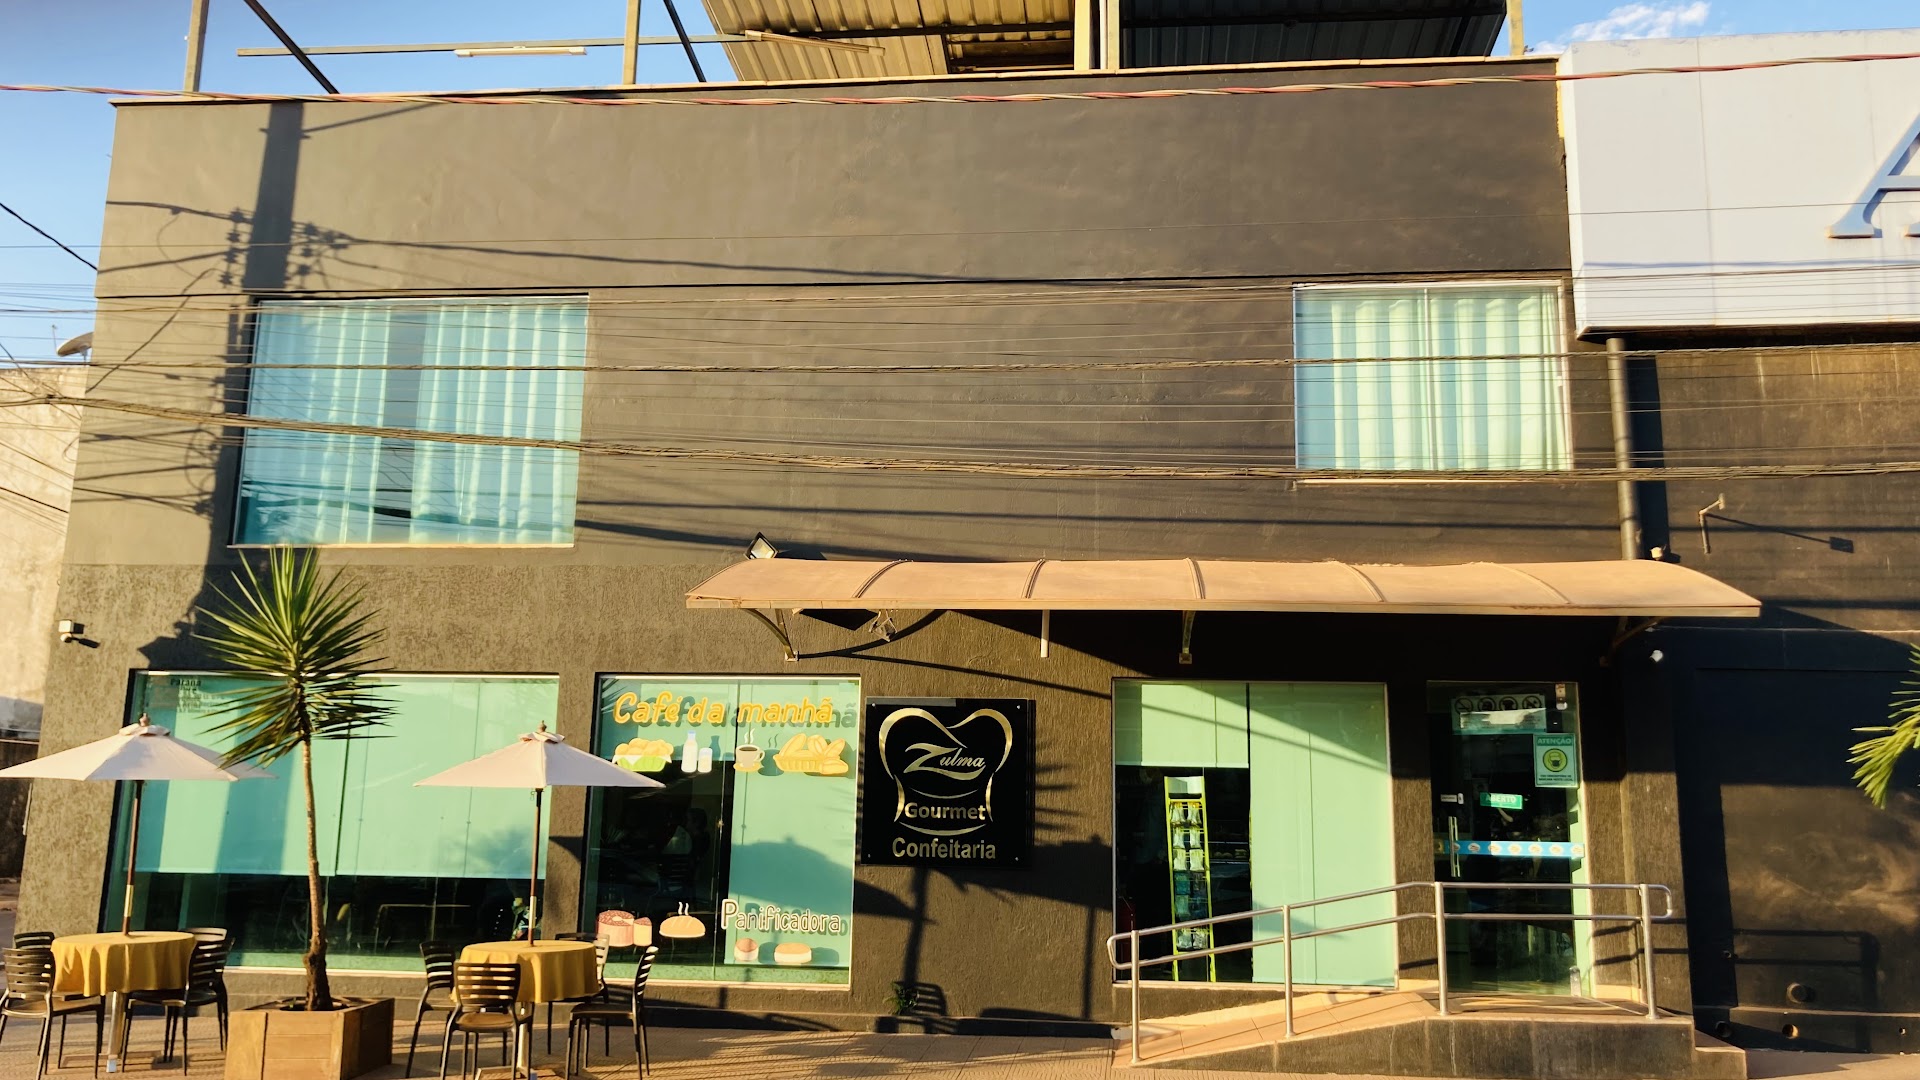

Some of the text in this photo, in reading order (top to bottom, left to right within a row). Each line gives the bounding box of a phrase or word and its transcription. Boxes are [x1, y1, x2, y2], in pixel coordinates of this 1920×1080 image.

[613, 690, 834, 724] Café da manhã
[1537, 737, 1572, 745] ATENÇÃO
[903, 742, 987, 781] Zulma
[1485, 793, 1516, 804] ABERTO
[904, 802, 986, 820] Gourmet
[892, 837, 996, 859] Confeitaria
[721, 898, 842, 932] Panificadora
